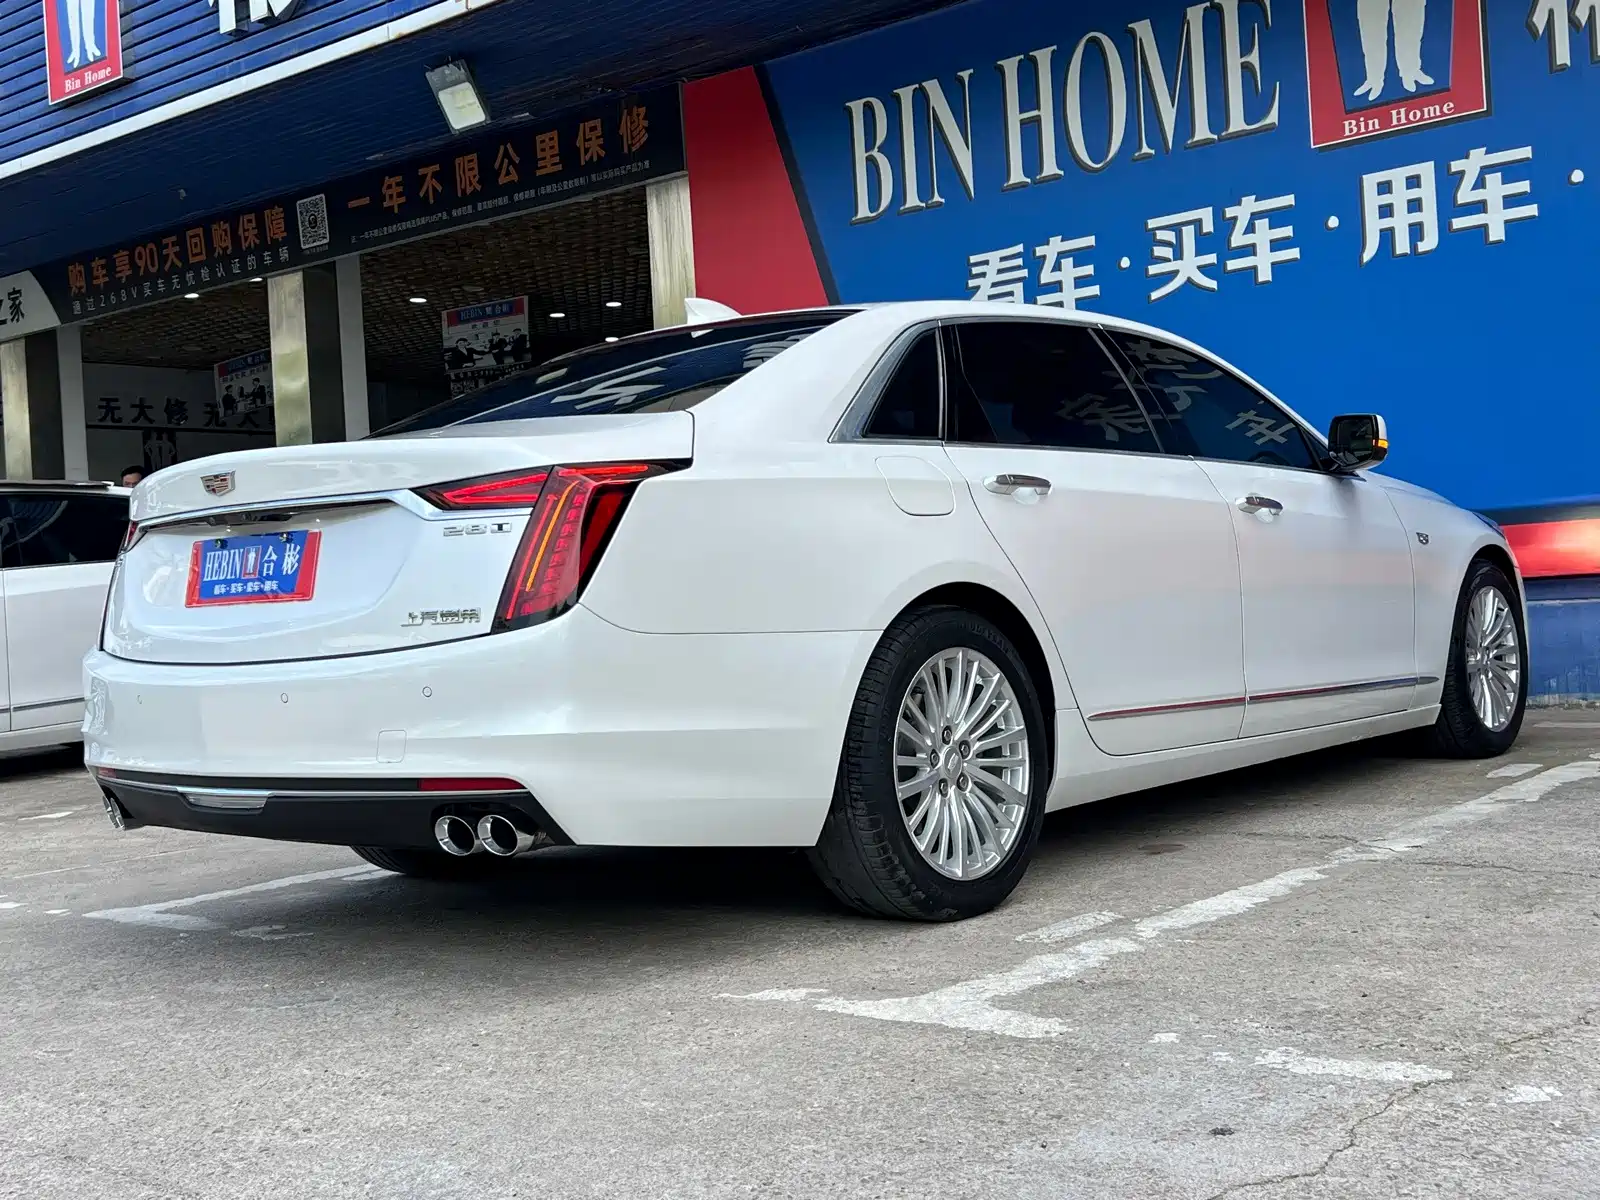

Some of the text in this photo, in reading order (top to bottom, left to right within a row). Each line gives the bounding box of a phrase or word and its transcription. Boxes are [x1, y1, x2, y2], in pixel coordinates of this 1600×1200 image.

[65, 66, 112, 93] Bin Home
[845, 0, 1280, 224] BIN HOME
[1343, 100, 1455, 137] Bin Home
[348, 105, 649, 214] 一年不限公里保修
[67, 205, 288, 296] 购车享90天回购保障
[443, 522, 512, 537] 28T
[203, 548, 244, 581] HEBIN
[262, 543, 300, 575] 合彬
